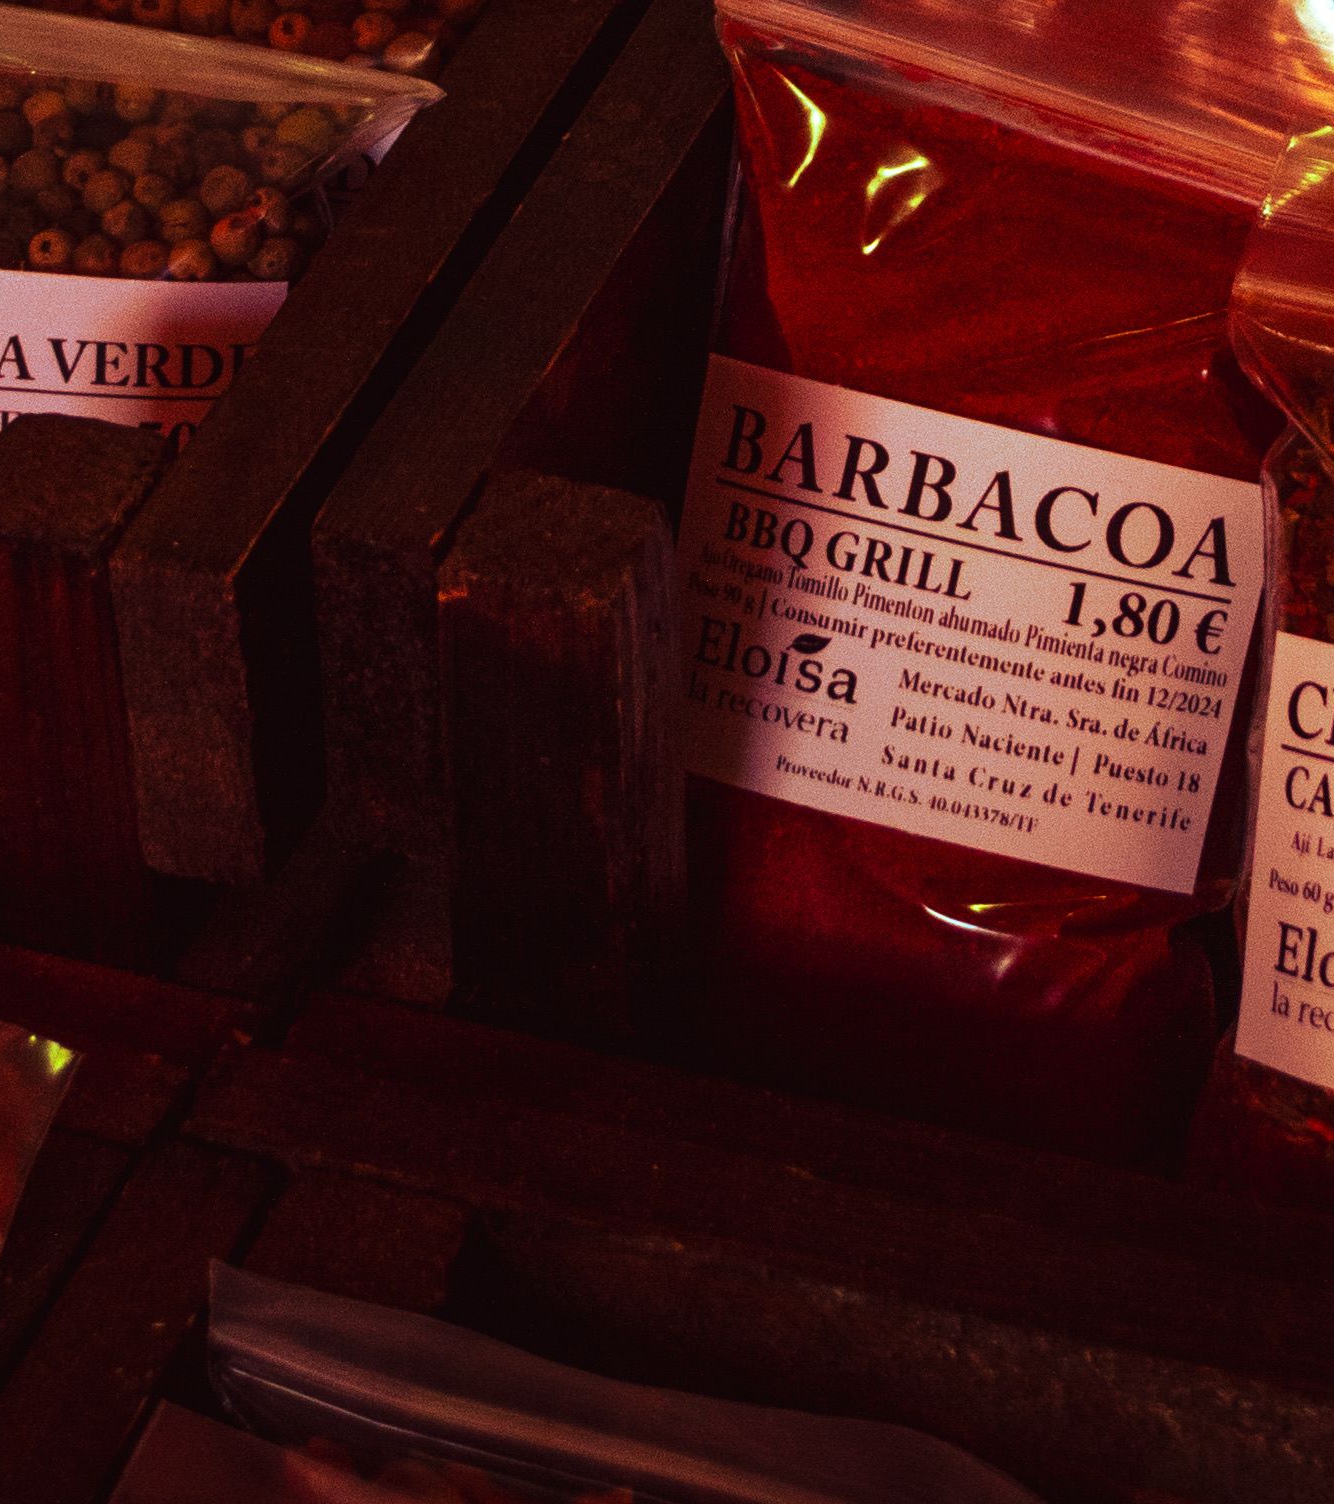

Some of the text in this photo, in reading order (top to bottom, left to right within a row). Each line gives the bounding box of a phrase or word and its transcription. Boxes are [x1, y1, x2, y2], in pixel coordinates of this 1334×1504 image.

[720, 402, 1237, 589] BARBACOA
[724, 502, 1229, 656] BBQ GRILL 1,80 €
[694, 615, 859, 706] Eloísa
[772, 597, 868, 640] Consumir
[868, 626, 1046, 684] preferentemente
[1049, 669, 1106, 696] antes
[1110, 677, 1140, 704] fin
[937, 604, 1020, 645] ahumado
[1024, 623, 1105, 665] Pimienta
[1108, 651, 1158, 677] negra
[717, 687, 850, 743] recovera
[890, 705, 1200, 794] Patio Naciente Puesto 18
[897, 667, 1207, 756] Mercado Ntra. Sra. de África
[880, 744, 1191, 832] Santa Cruz de Tenerife
[1270, 980, 1291, 1019] la
